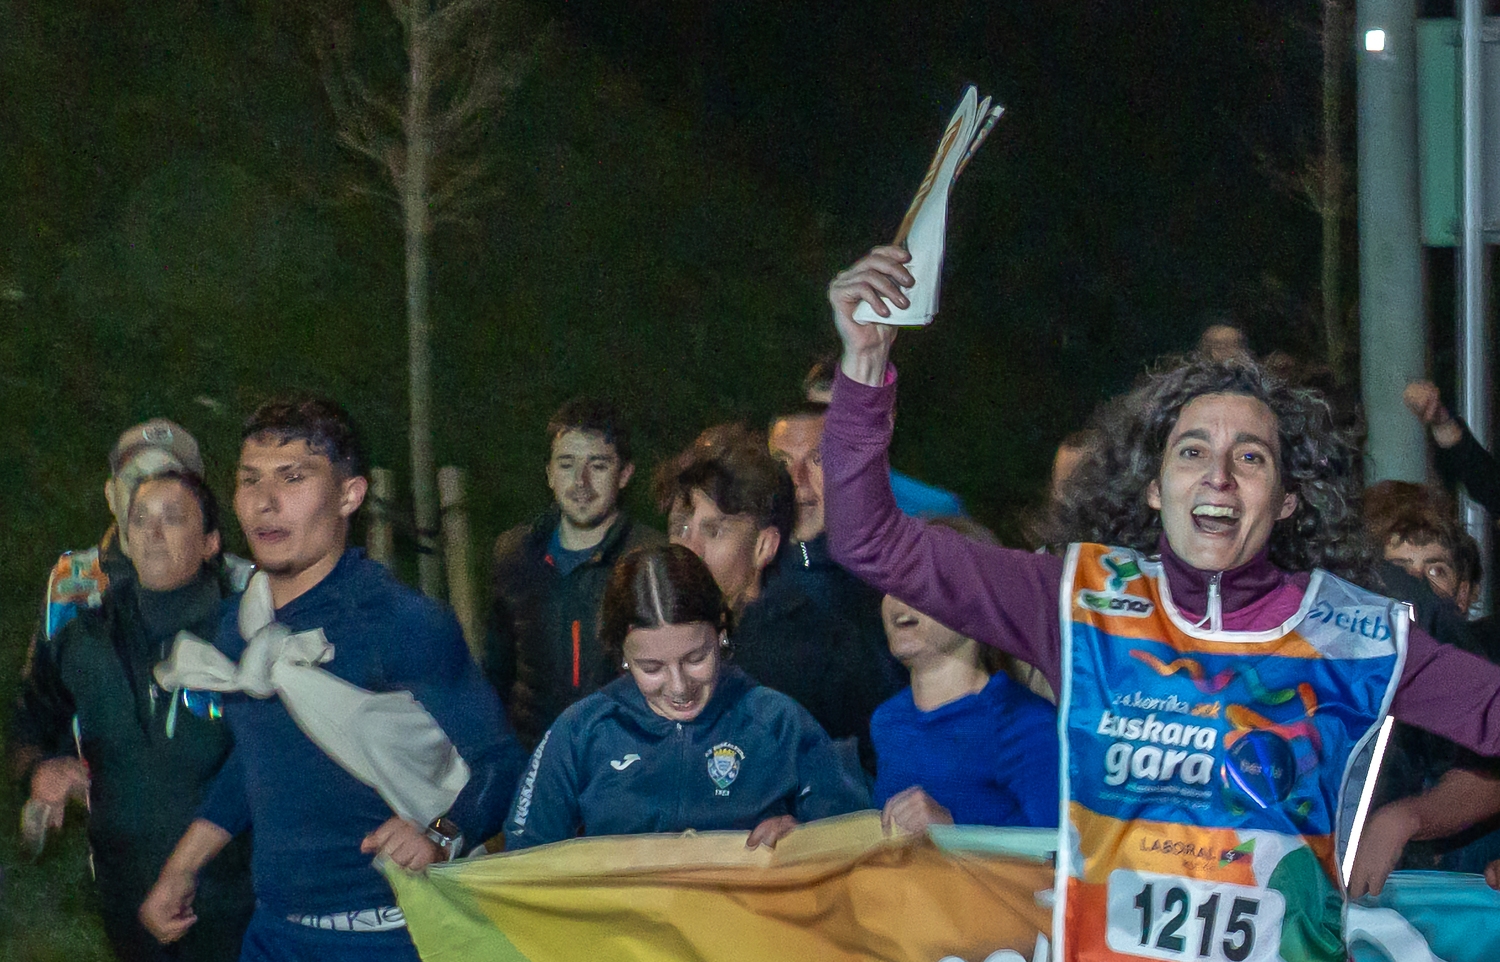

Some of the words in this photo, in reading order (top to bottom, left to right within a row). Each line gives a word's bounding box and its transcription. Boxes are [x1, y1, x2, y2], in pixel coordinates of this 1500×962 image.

[1336, 604, 1391, 641] eitb
[1096, 709, 1218, 753] Euskara
[1103, 742, 1216, 787] gara
[1133, 882, 1260, 962] 1215
